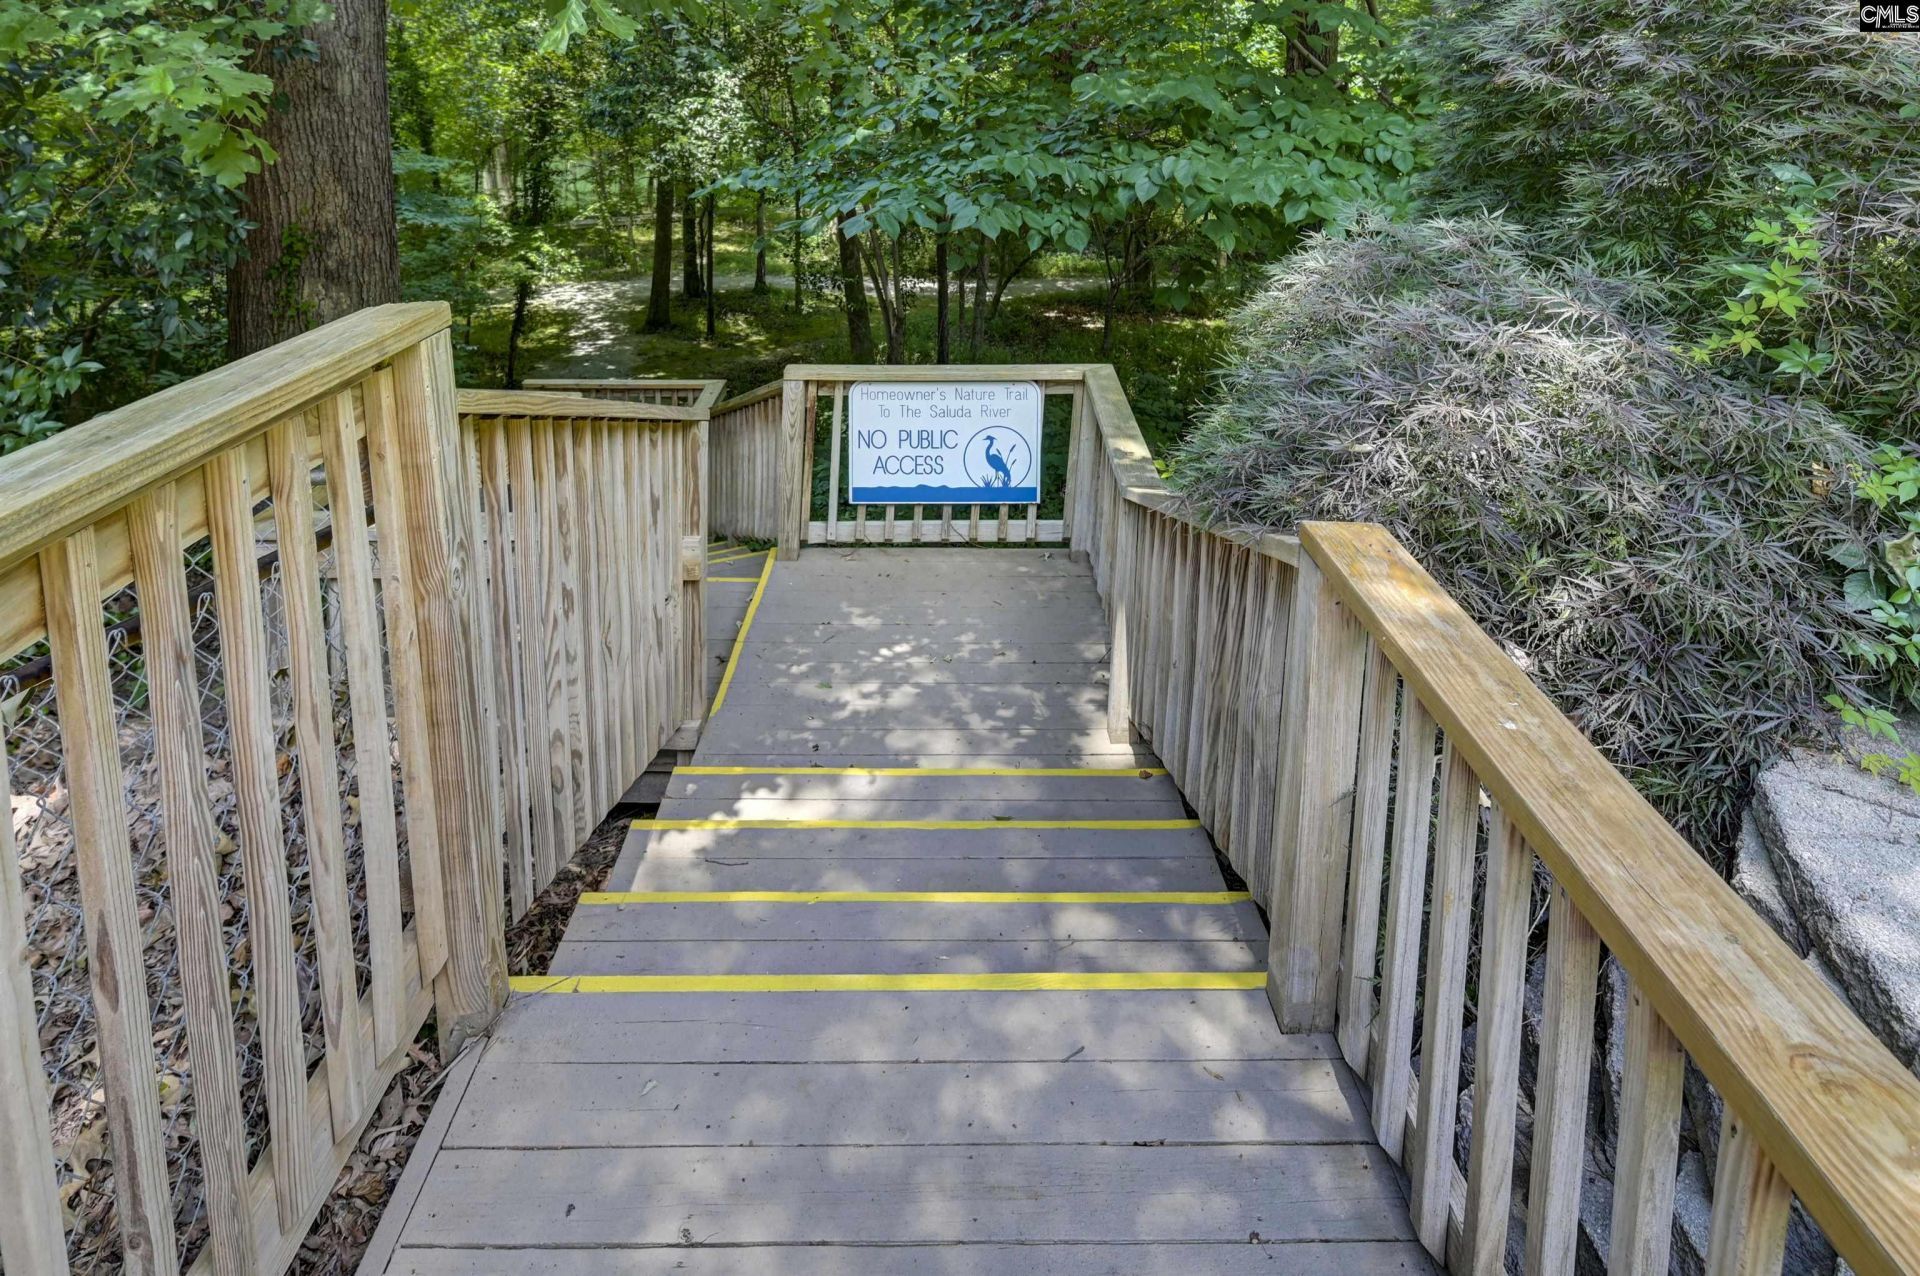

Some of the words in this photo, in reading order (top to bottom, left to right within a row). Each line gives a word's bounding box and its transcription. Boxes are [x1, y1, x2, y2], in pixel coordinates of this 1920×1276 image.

[860, 387, 946, 401] Homeowner's
[954, 387, 995, 401] Nature
[1004, 387, 1028, 401] Trail
[878, 404, 890, 418] To
[900, 404, 921, 418] The
[930, 404, 972, 418] Saluda
[980, 404, 1012, 418] River
[857, 429, 887, 449] NO
[898, 429, 958, 449] PUBLIC
[872, 455, 944, 475] ACCESS
